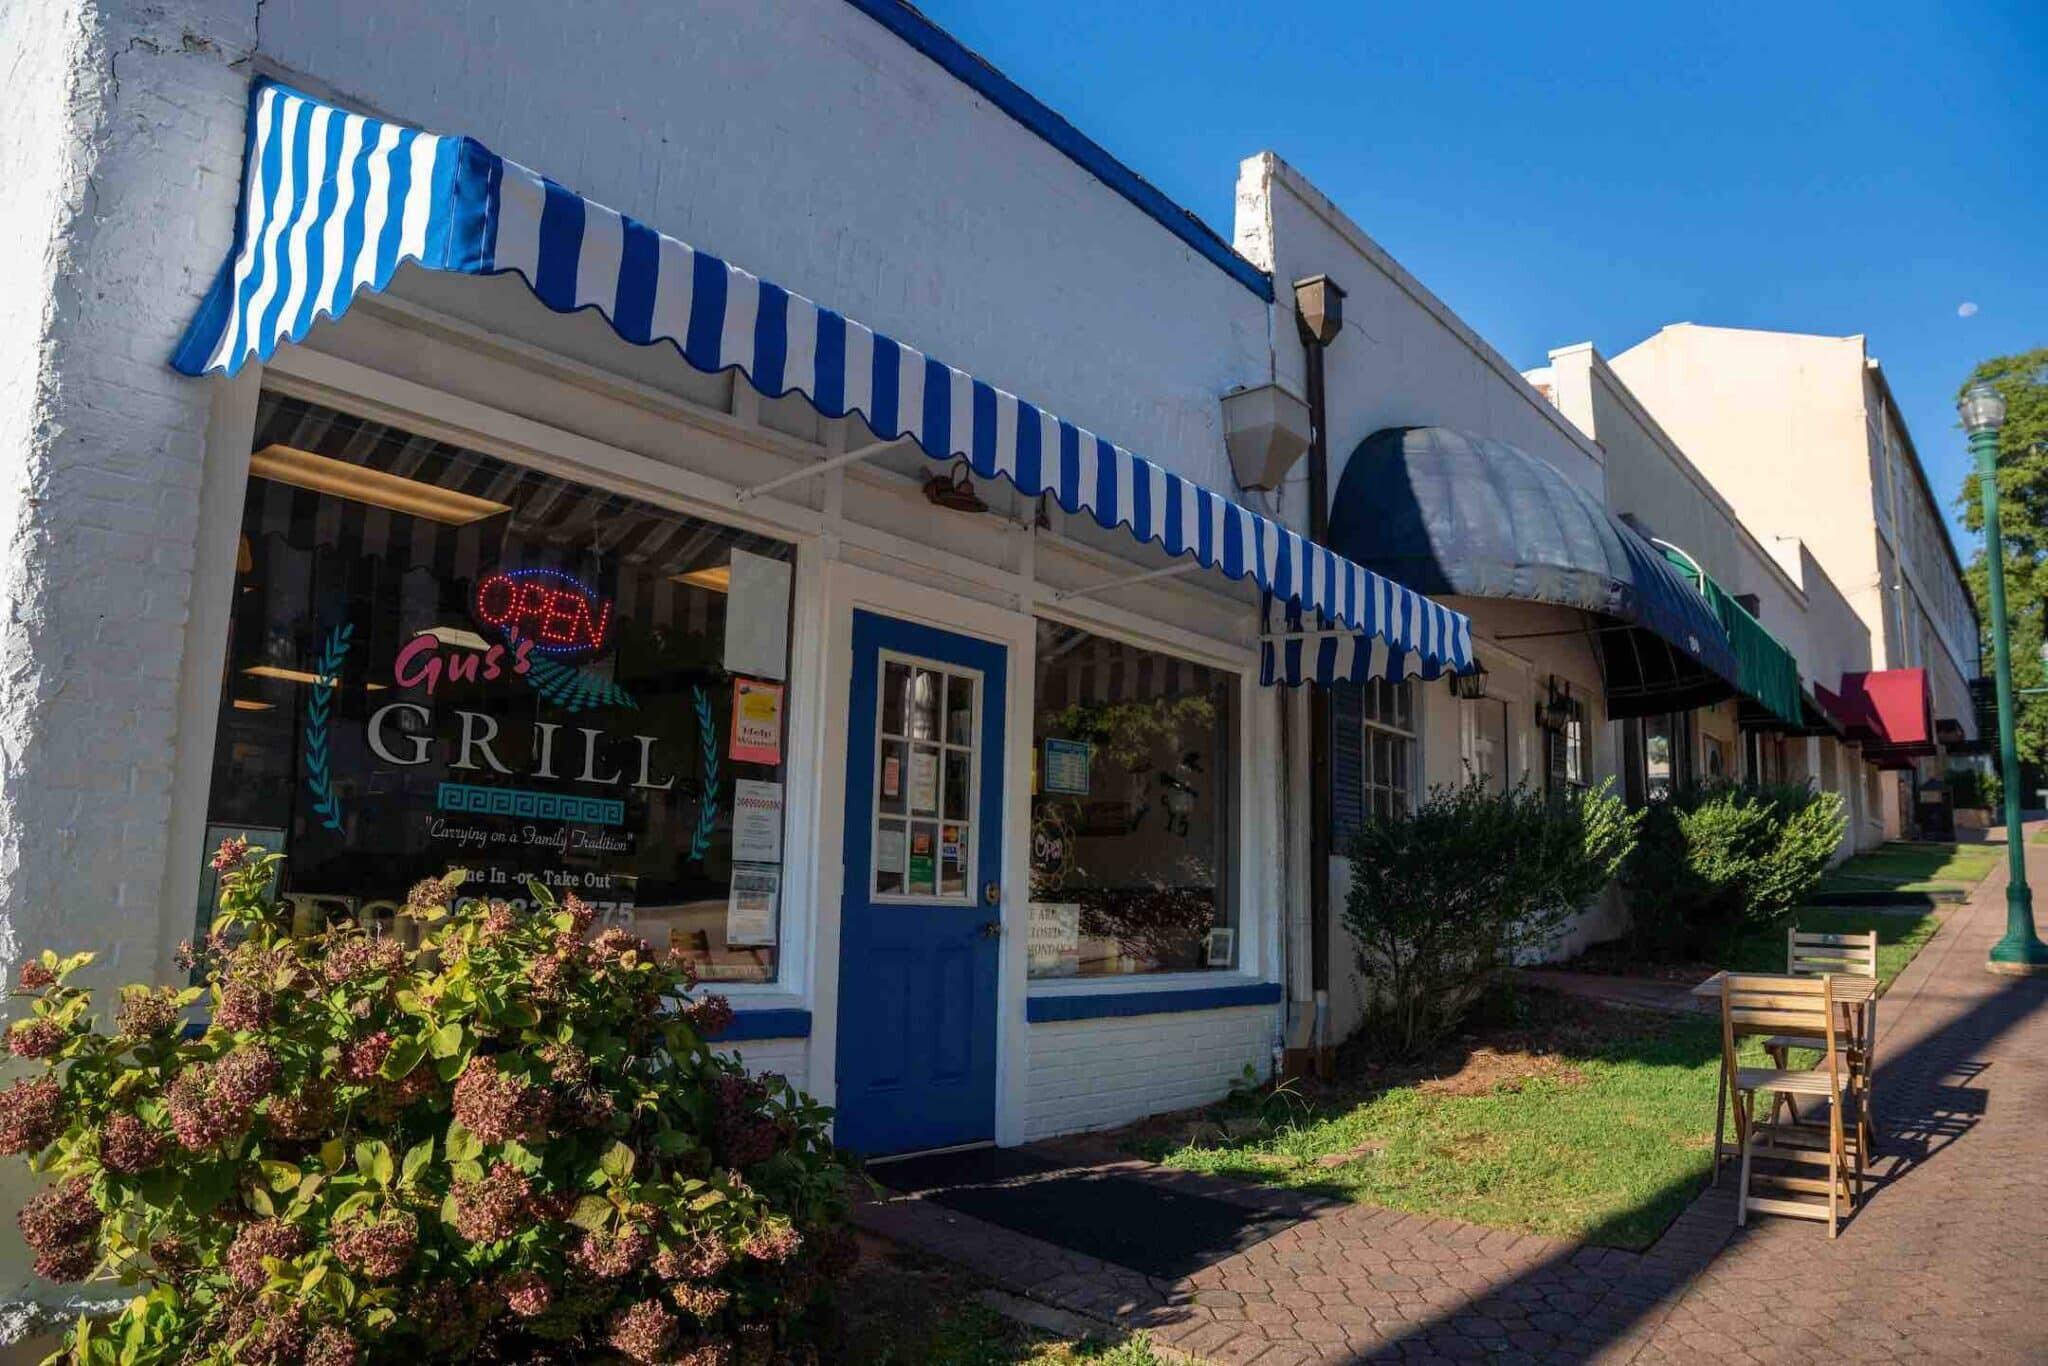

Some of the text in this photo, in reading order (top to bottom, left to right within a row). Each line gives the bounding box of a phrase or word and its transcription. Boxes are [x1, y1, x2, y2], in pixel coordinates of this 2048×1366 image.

[479, 575, 610, 649] OPEN
[394, 626, 535, 696] Gus's
[367, 702, 676, 790] GRILL
[425, 816, 633, 854] "Carrying on a Family Tradition"
[447, 865, 485, 882] ne
[490, 867, 506, 883] In
[543, 870, 579, 887] Take
[583, 872, 611, 888] Out
